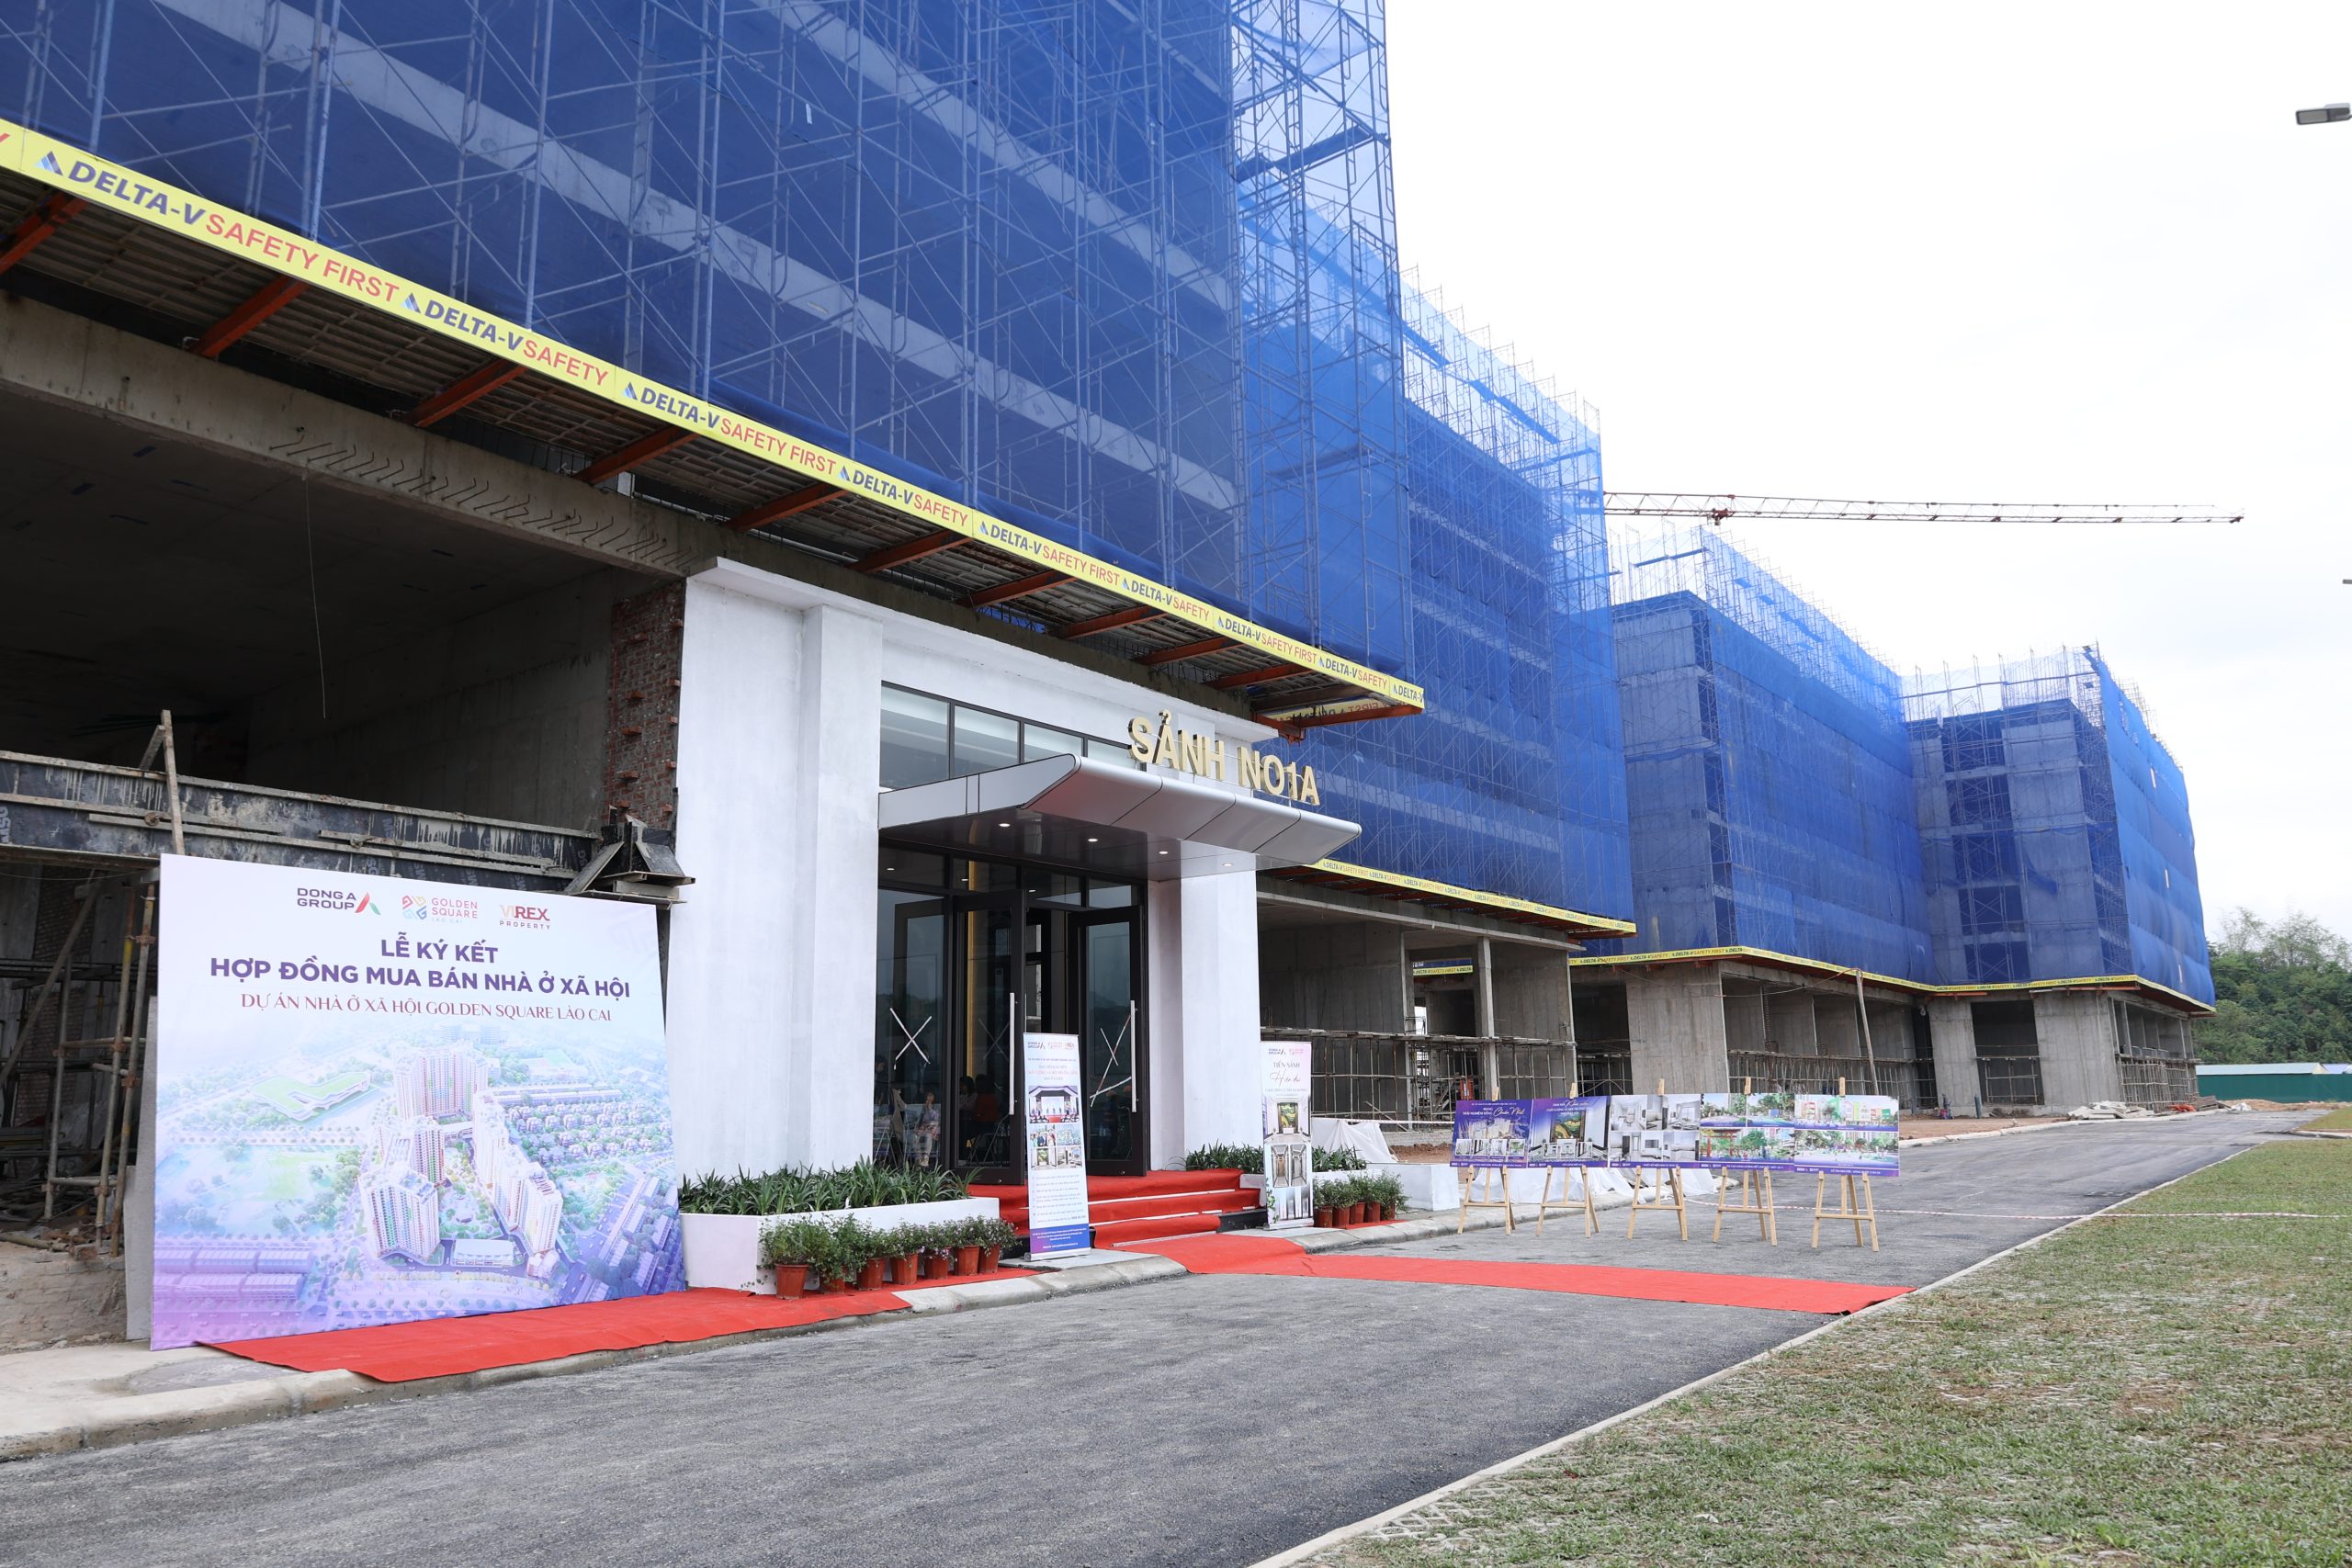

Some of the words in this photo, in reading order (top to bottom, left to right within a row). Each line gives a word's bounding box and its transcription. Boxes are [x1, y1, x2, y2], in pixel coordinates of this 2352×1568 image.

[68, 161, 206, 225] DELTA-V
[205, 213, 320, 270] SAFETY
[322, 258, 400, 302] FIRST
[424, 299, 525, 351] DELTA-V
[523, 340, 609, 386] SAFETY
[640, 388, 720, 429] DELTA-V
[720, 418, 787, 457] SAFETY
[789, 445, 837, 475] FIRST
[852, 469, 914, 505] DELTA-V
[913, 494, 968, 526] SAFETY
[990, 525, 1042, 555] DELTA-V
[1043, 545, 1088, 572] SAFETY
[1089, 563, 1120, 586] FIRST
[1131, 580, 1173, 606] DELTA-V
[1172, 597, 1210, 621] SAFETY
[1225, 618, 1261, 642] DELTA-V
[1261, 633, 1294, 654] SAFETY
[1295, 646, 1317, 664] FIRST
[1325, 659, 1358, 679] DELTA-V
[1357, 671, 1388, 690] SAFETY
[1128, 709, 1225, 781] SẢNH
[297, 887, 344, 900] DONG
[297, 897, 355, 910] GROUP
[431, 897, 478, 909] GOLDEN
[431, 907, 478, 919] SQUARE
[500, 904, 550, 921] VIREX
[499, 920, 550, 931] PROPERTY
[381, 931, 410, 958] LỄ
[417, 939, 448, 961] KÝ
[455, 939, 499, 964] KẾT
[210, 957, 271, 983] HỢP
[278, 955, 358, 983] ĐỒNG
[367, 966, 422, 987] MUA
[428, 966, 478, 989] BÁN
[484, 971, 533, 992] NHÀ
[538, 970, 555, 994] Ở
[560, 976, 590, 996] XÃ
[594, 976, 630, 1001] HỘI
[241, 993, 271, 1011] DỰ
[274, 992, 300, 1009] ÁN
[305, 995, 343, 1011] NHÀ
[347, 994, 360, 1011] Ở
[365, 997, 389, 1012] XÃ
[392, 998, 422, 1016] HỘI
[425, 1001, 492, 1016] GOLDEN
[495, 1005, 553, 1021] SQUARE
[557, 1005, 585, 1021] LÀO
[588, 1009, 612, 1021] CAI
